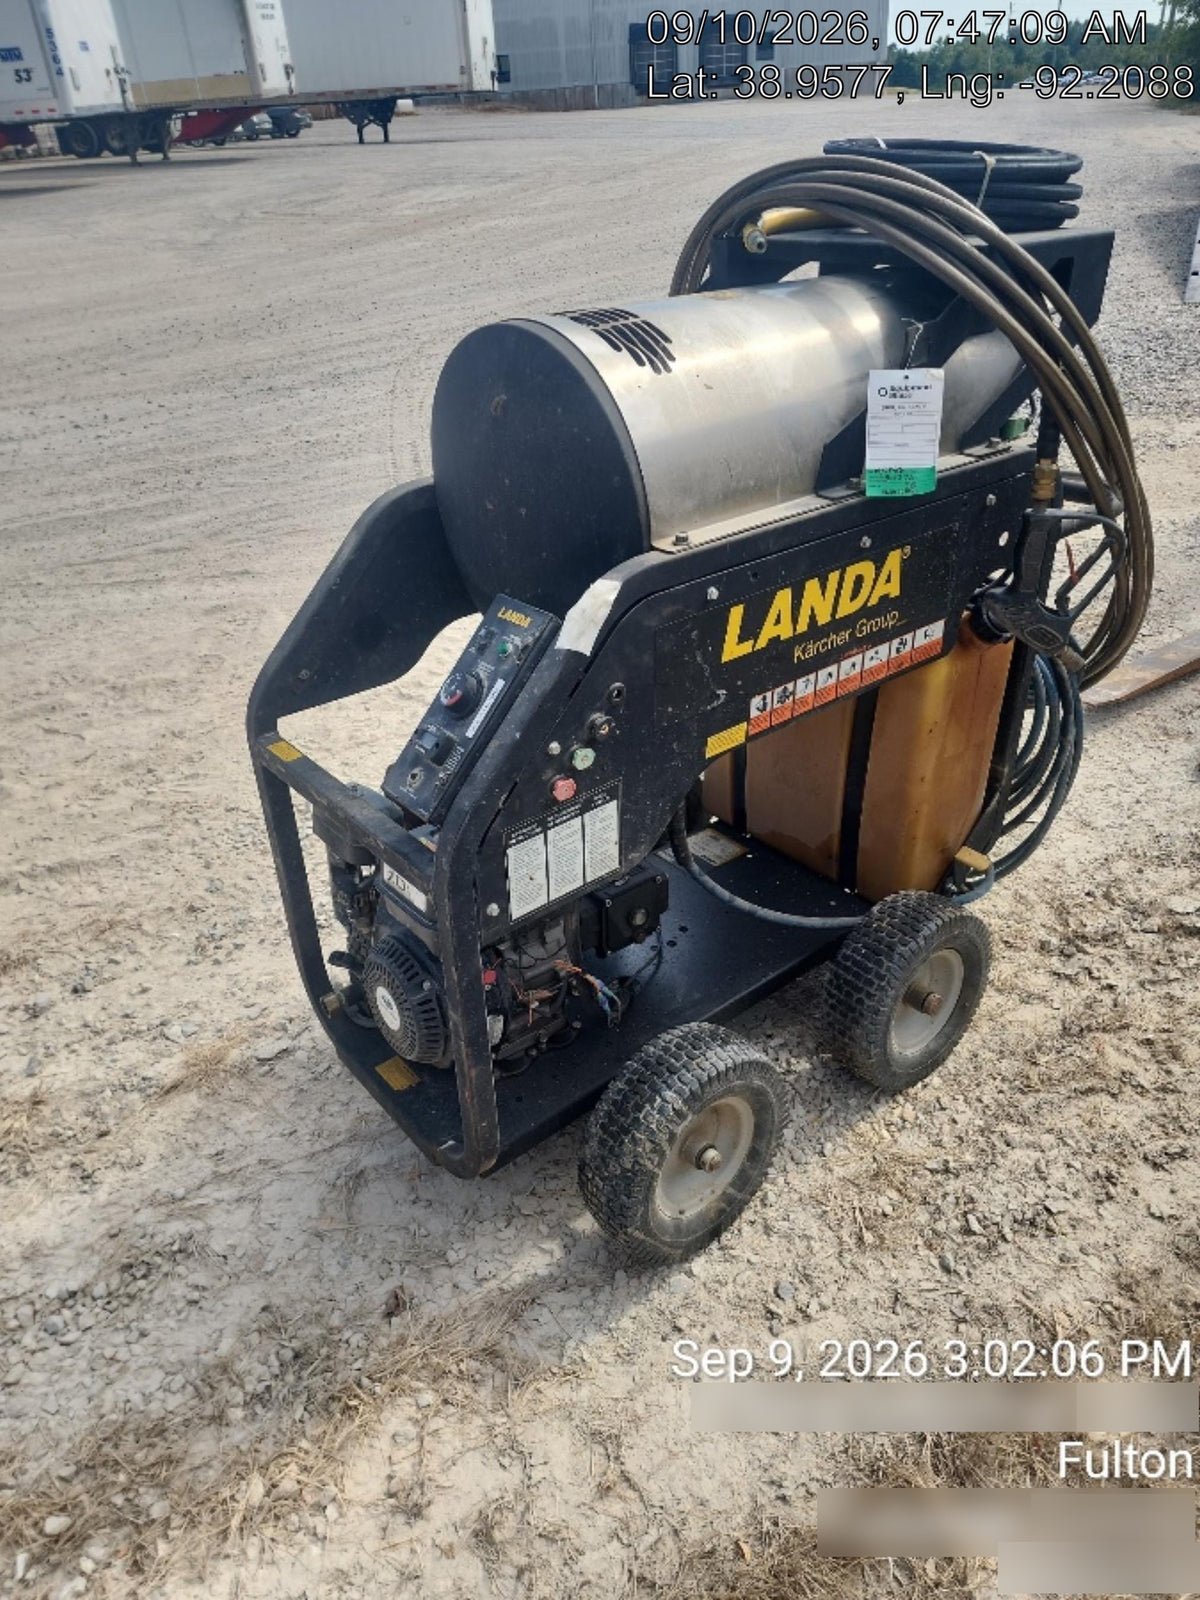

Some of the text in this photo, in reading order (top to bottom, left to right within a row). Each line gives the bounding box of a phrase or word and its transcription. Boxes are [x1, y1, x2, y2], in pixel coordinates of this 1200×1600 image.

[497, 606, 532, 629] LANDA
[721, 549, 902, 664] LANDA
[794, 627, 852, 663] Kärcher
[855, 610, 899, 638] Group
